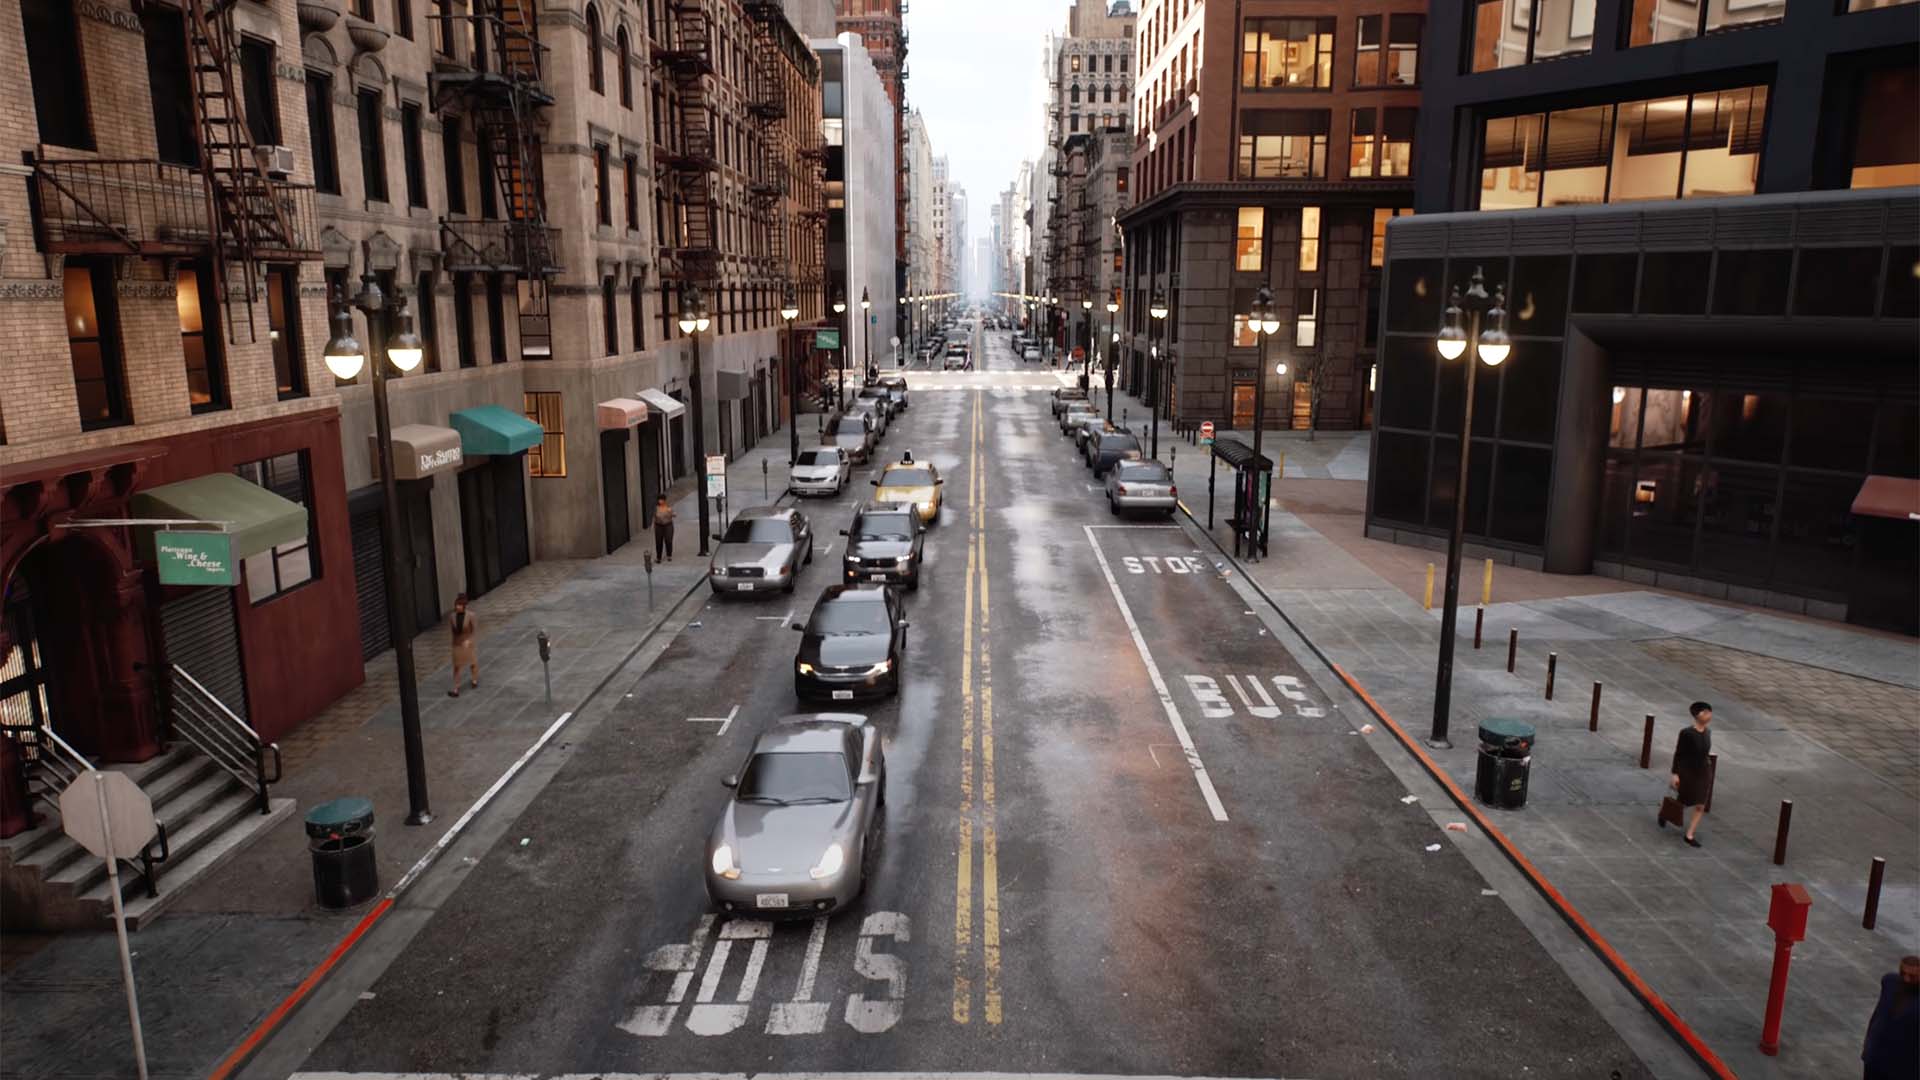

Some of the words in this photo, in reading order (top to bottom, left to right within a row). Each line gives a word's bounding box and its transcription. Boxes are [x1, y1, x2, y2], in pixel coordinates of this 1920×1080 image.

[175, 552, 198, 560] Wine
[200, 551, 208, 560] &
[190, 559, 222, 568] Cheese
[1121, 556, 1206, 574] STOP
[1182, 674, 1326, 718] BUS
